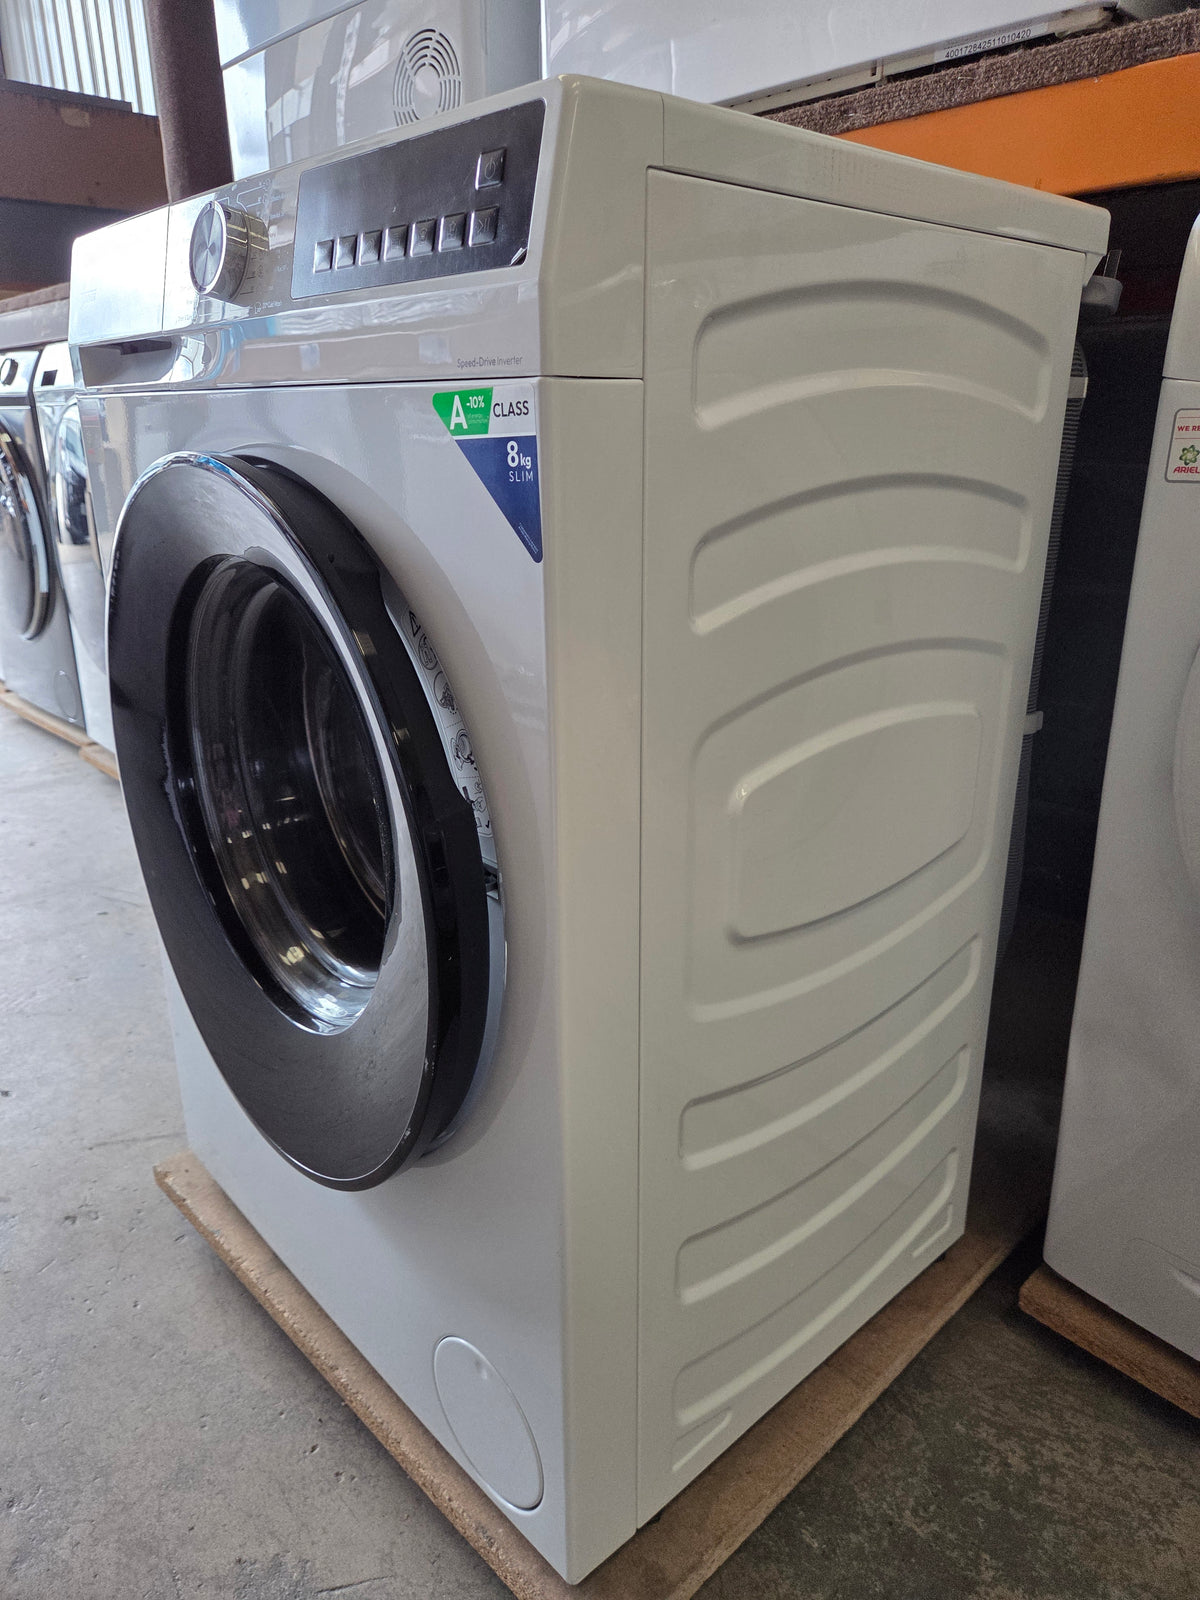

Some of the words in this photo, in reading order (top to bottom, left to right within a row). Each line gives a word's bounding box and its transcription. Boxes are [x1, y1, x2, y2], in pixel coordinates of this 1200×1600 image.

[456, 356, 496, 370] Speed-Drive
[497, 355, 523, 366] Inverter
[450, 394, 468, 430] A
[466, 395, 485, 409] -10%
[493, 400, 529, 418] CLASS
[509, 470, 534, 482] SLIM
[1173, 466, 1200, 474] ARIEL
